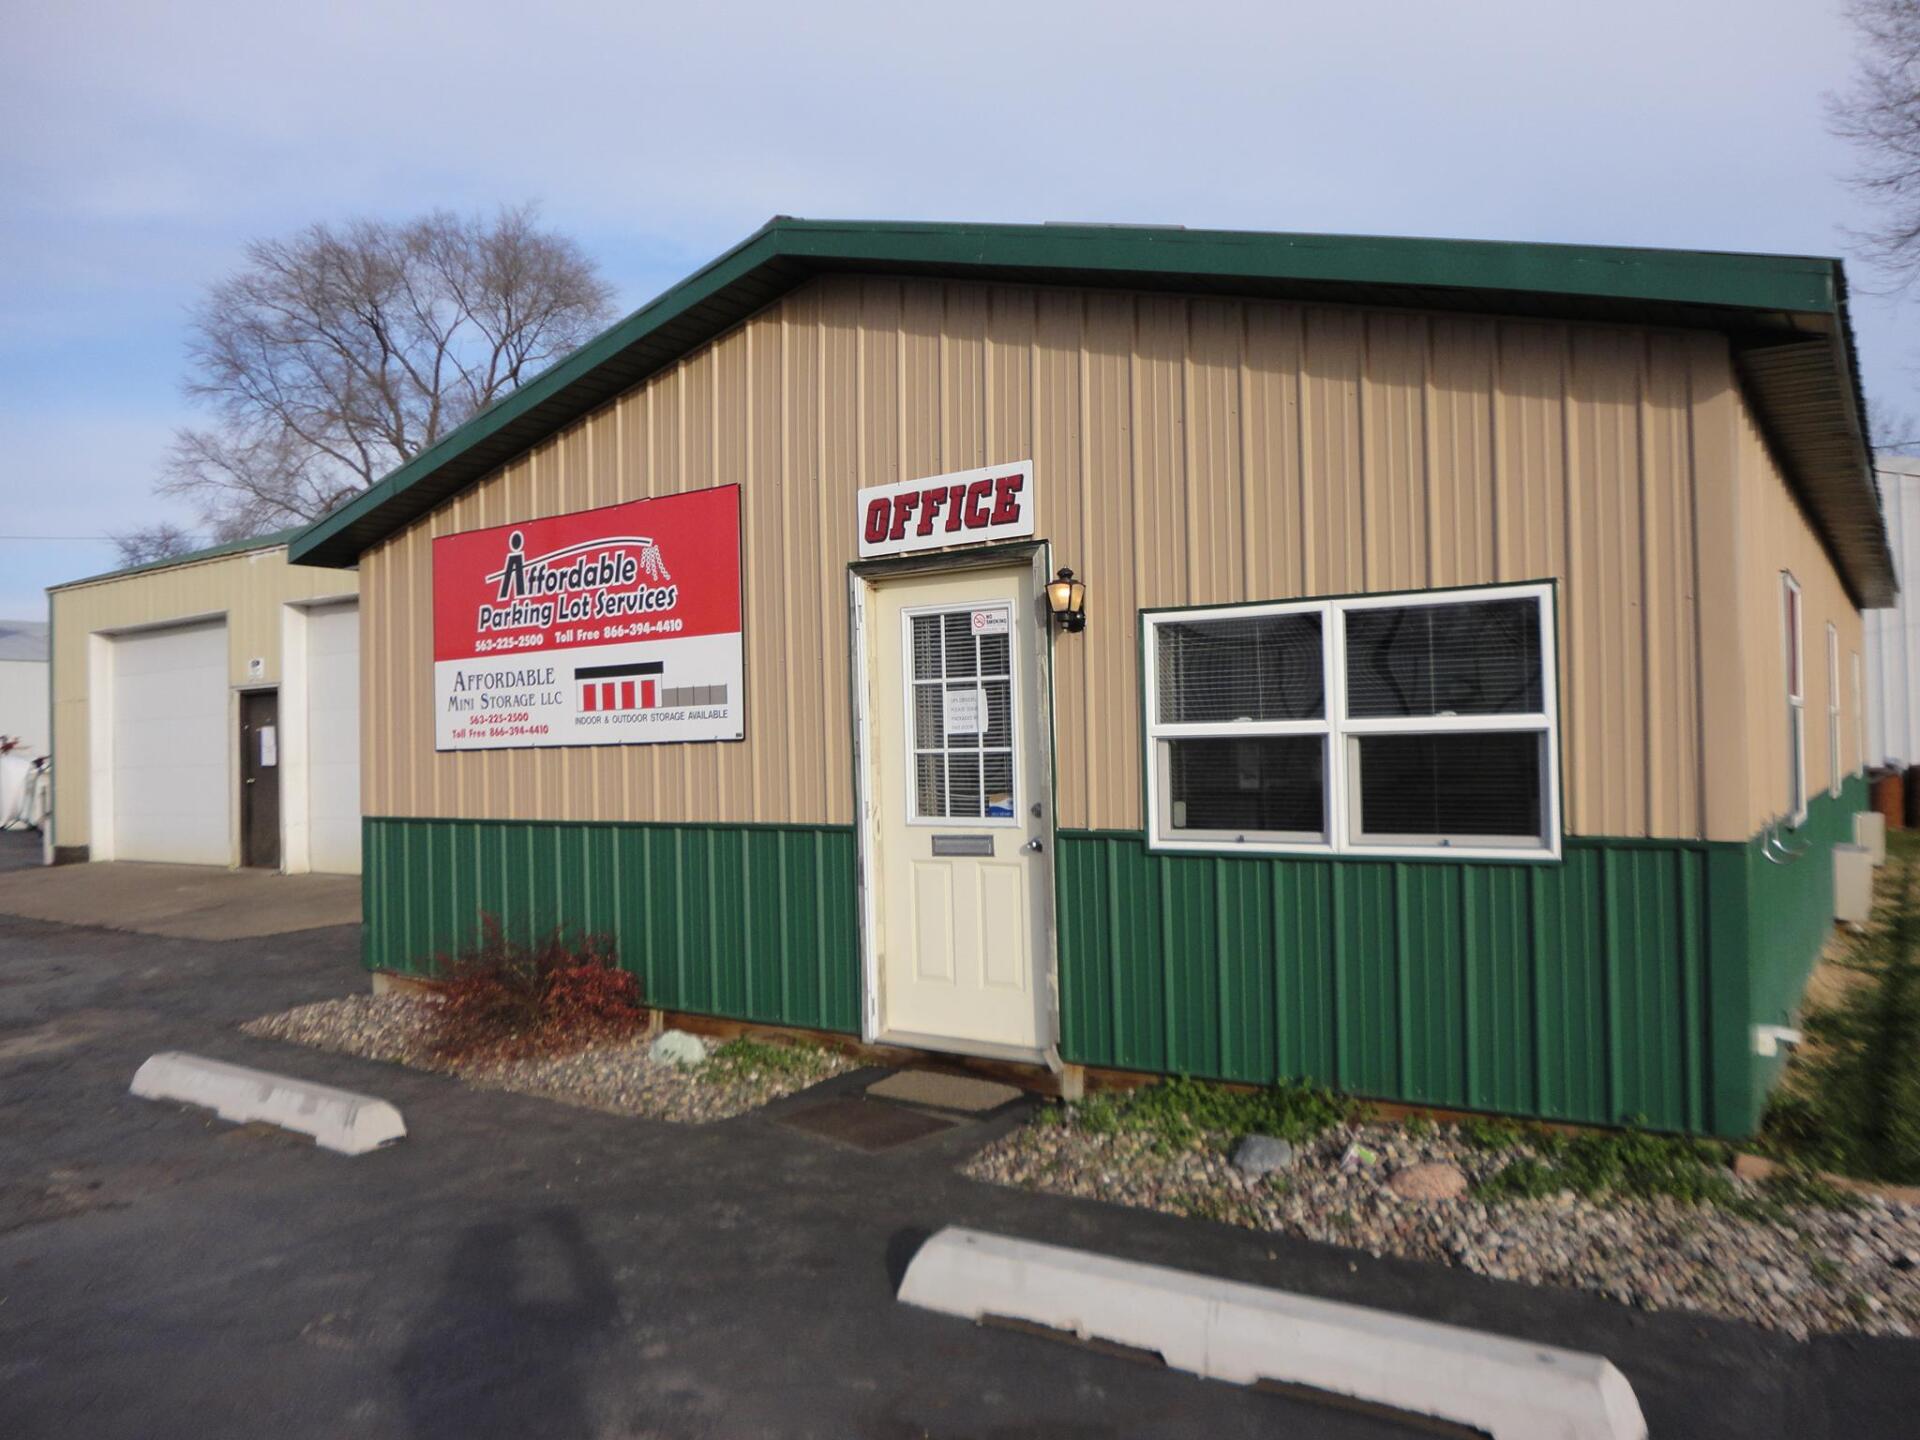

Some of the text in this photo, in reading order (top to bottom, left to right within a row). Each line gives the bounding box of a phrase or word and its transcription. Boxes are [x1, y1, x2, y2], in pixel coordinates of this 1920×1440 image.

[864, 474, 1024, 543] OFFICE
[497, 550, 638, 602] Affordable
[478, 583, 678, 633] Parking Lot Services
[475, 618, 683, 652] 563-225-2500 Toll Free 866-394-4410
[453, 667, 556, 692] AFFORDABLE
[447, 691, 564, 712] MINI STORAGE LLC
[469, 712, 529, 725] 563-225-2500
[575, 709, 728, 725] INDOOR & OUTDOOR STORAGE AVAILABLE
[452, 724, 549, 739] Toll Free 866-394-4410
